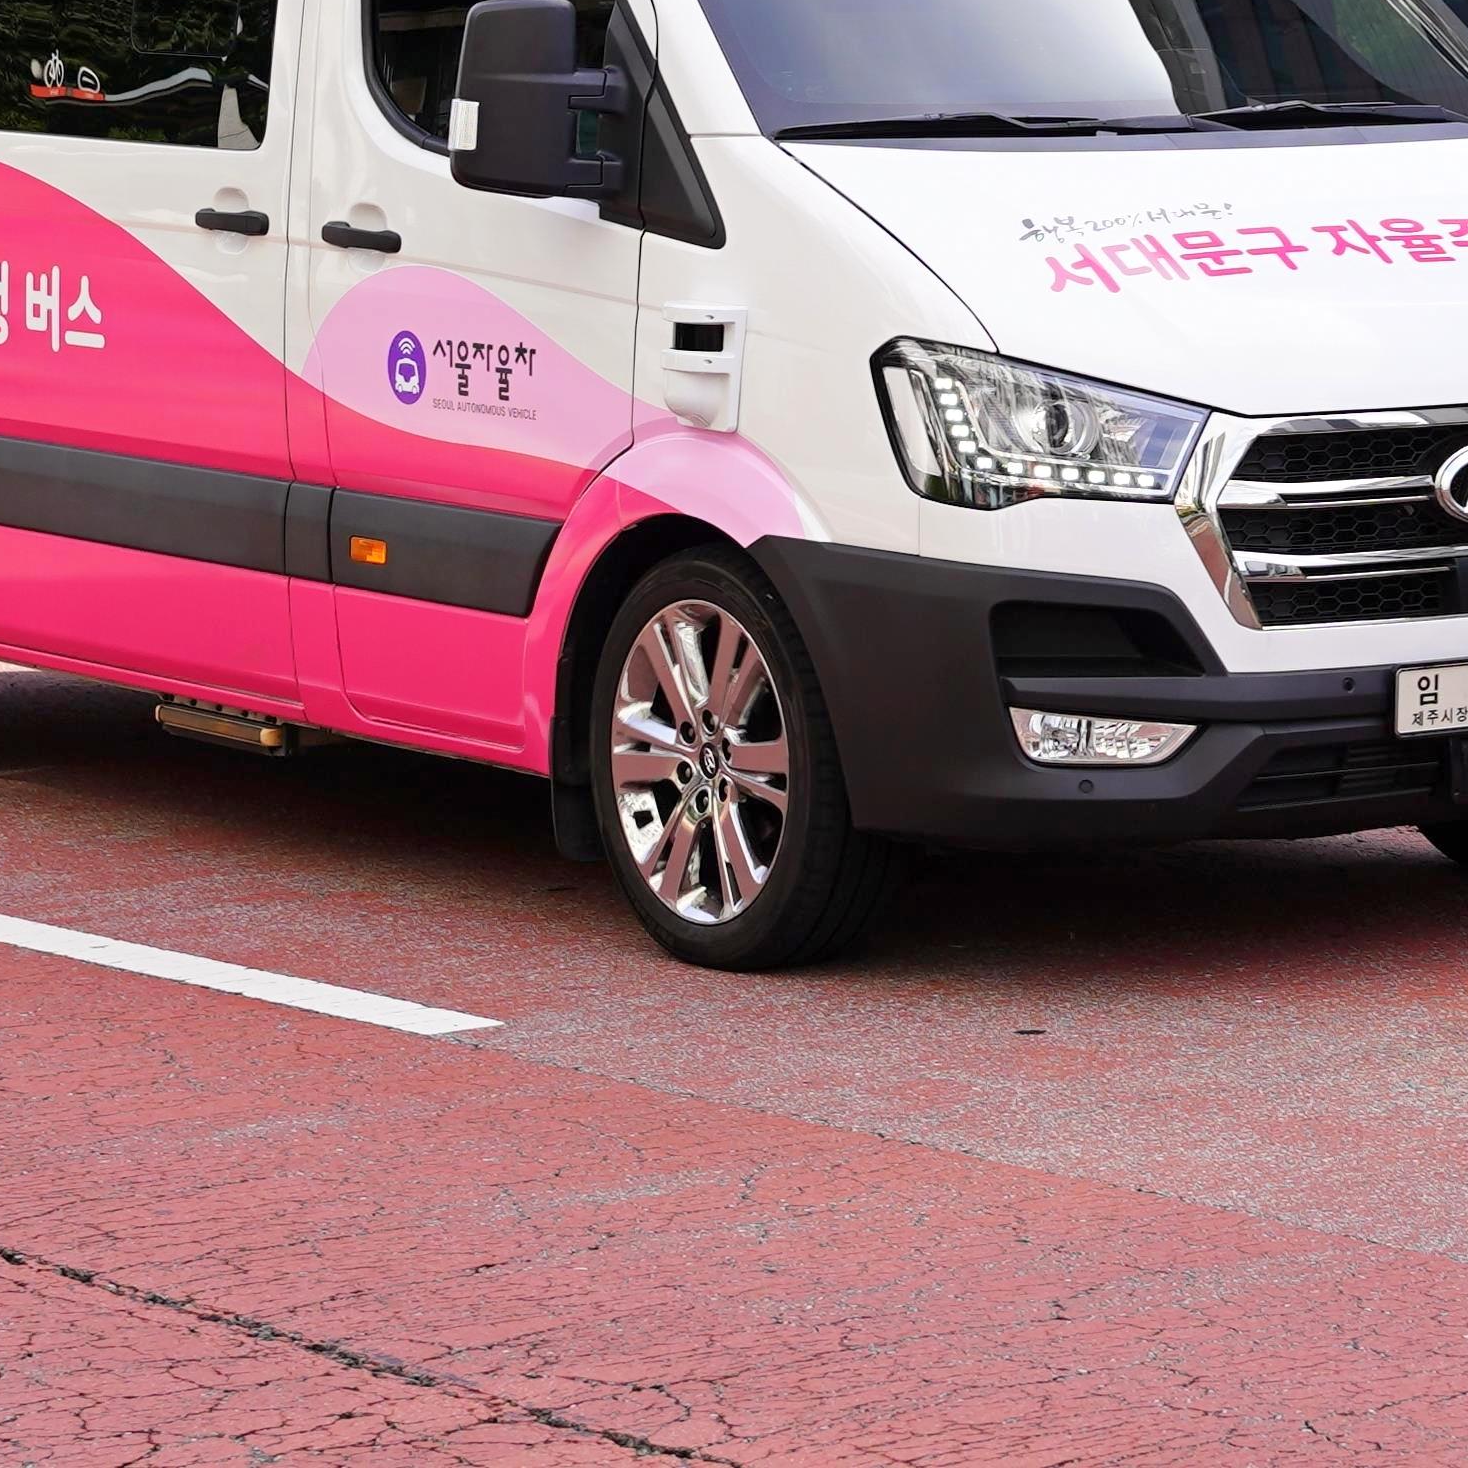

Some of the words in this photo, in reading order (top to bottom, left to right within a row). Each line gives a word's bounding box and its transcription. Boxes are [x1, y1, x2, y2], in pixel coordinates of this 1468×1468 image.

[1045, 226, 1309, 293] 서대문구
[25, 265, 107, 352] 버스
[432, 339, 537, 402] 서울자율차
[432, 398, 456, 411] SEOUL
[456, 401, 506, 418] AUTONOMOUS
[507, 407, 537, 421] VEHICLE
[1417, 674, 1440, 706] 임
